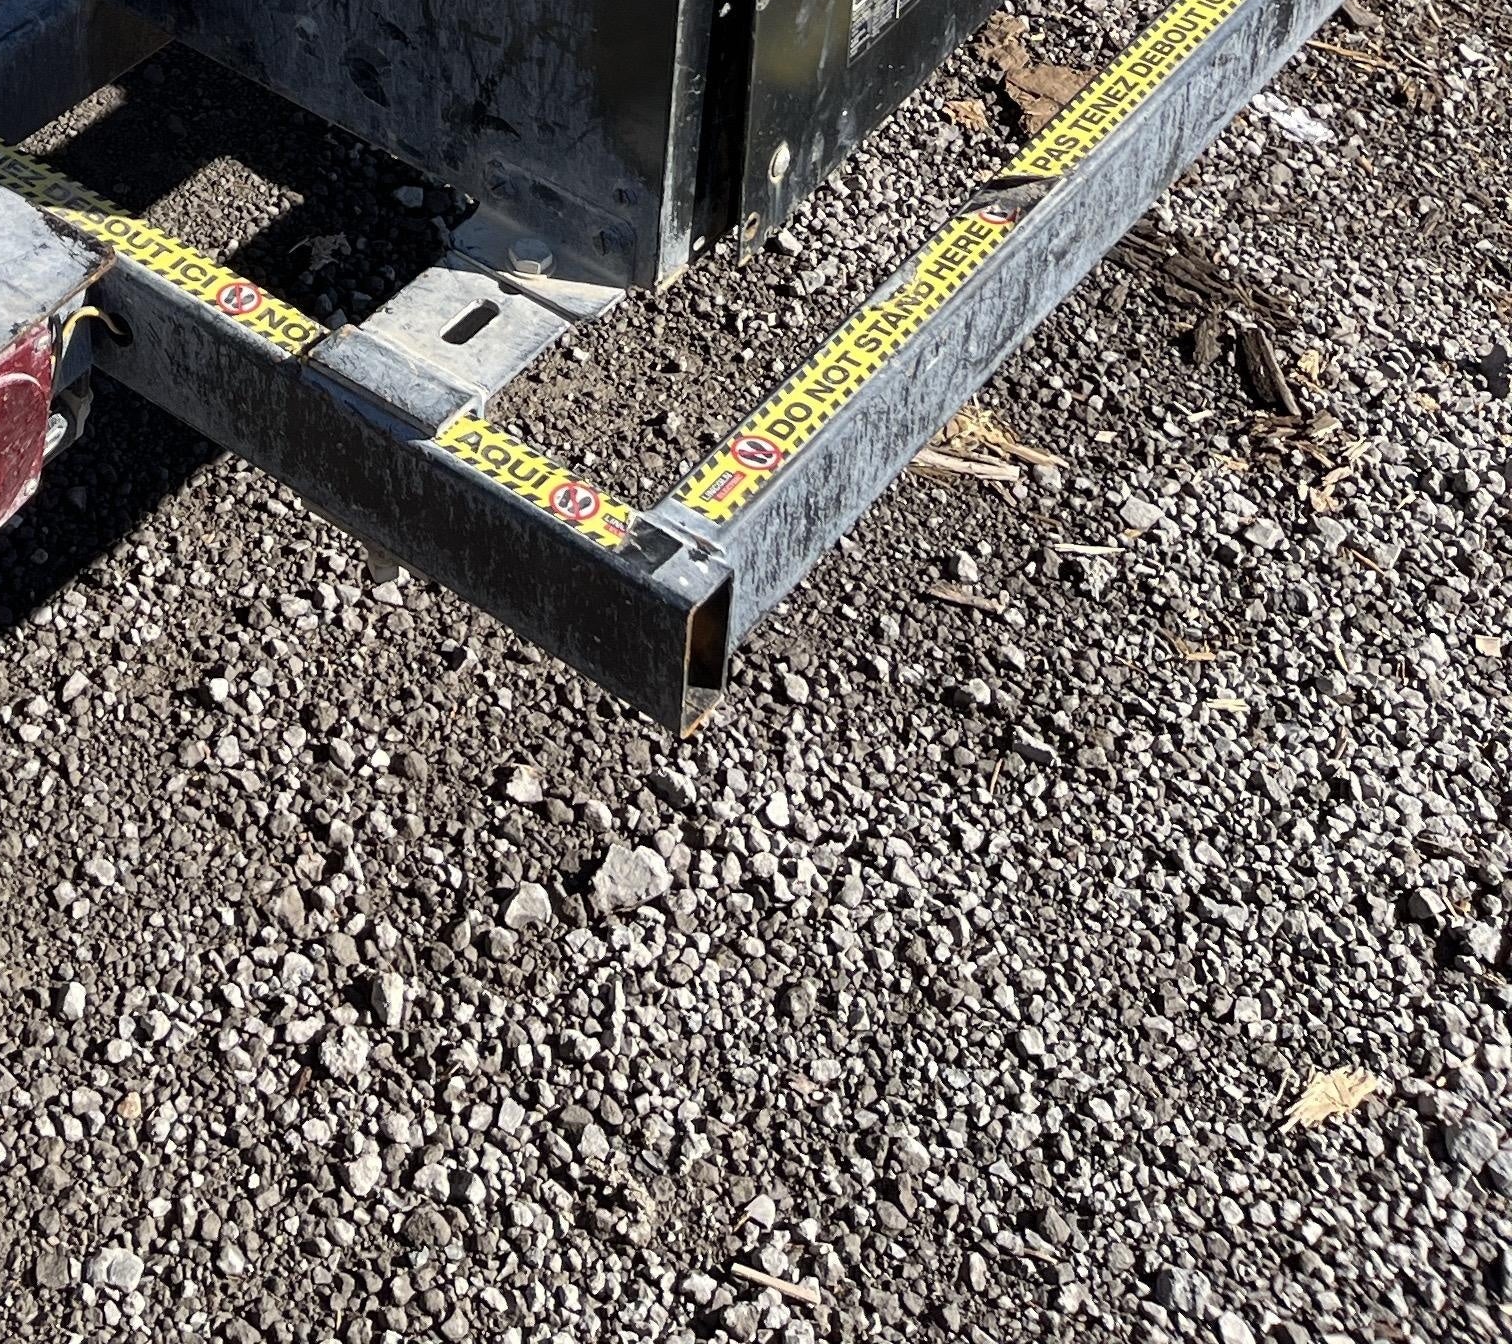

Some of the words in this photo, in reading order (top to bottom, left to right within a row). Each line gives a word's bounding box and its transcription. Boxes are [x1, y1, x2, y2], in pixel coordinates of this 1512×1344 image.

[1031, 130, 1081, 173] PAS
[1067, 79, 1139, 140] TENEZ
[1132, 10, 1215, 79] DEBOUT
[46, 183, 176, 259] DEBOUT
[168, 258, 218, 290] ICI
[255, 306, 315, 345] NO
[765, 401, 814, 441] DO
[802, 350, 862, 404] NOT
[853, 280, 936, 354] STAND
[924, 220, 994, 282] HERE
[701, 470, 734, 502] LINCOLN
